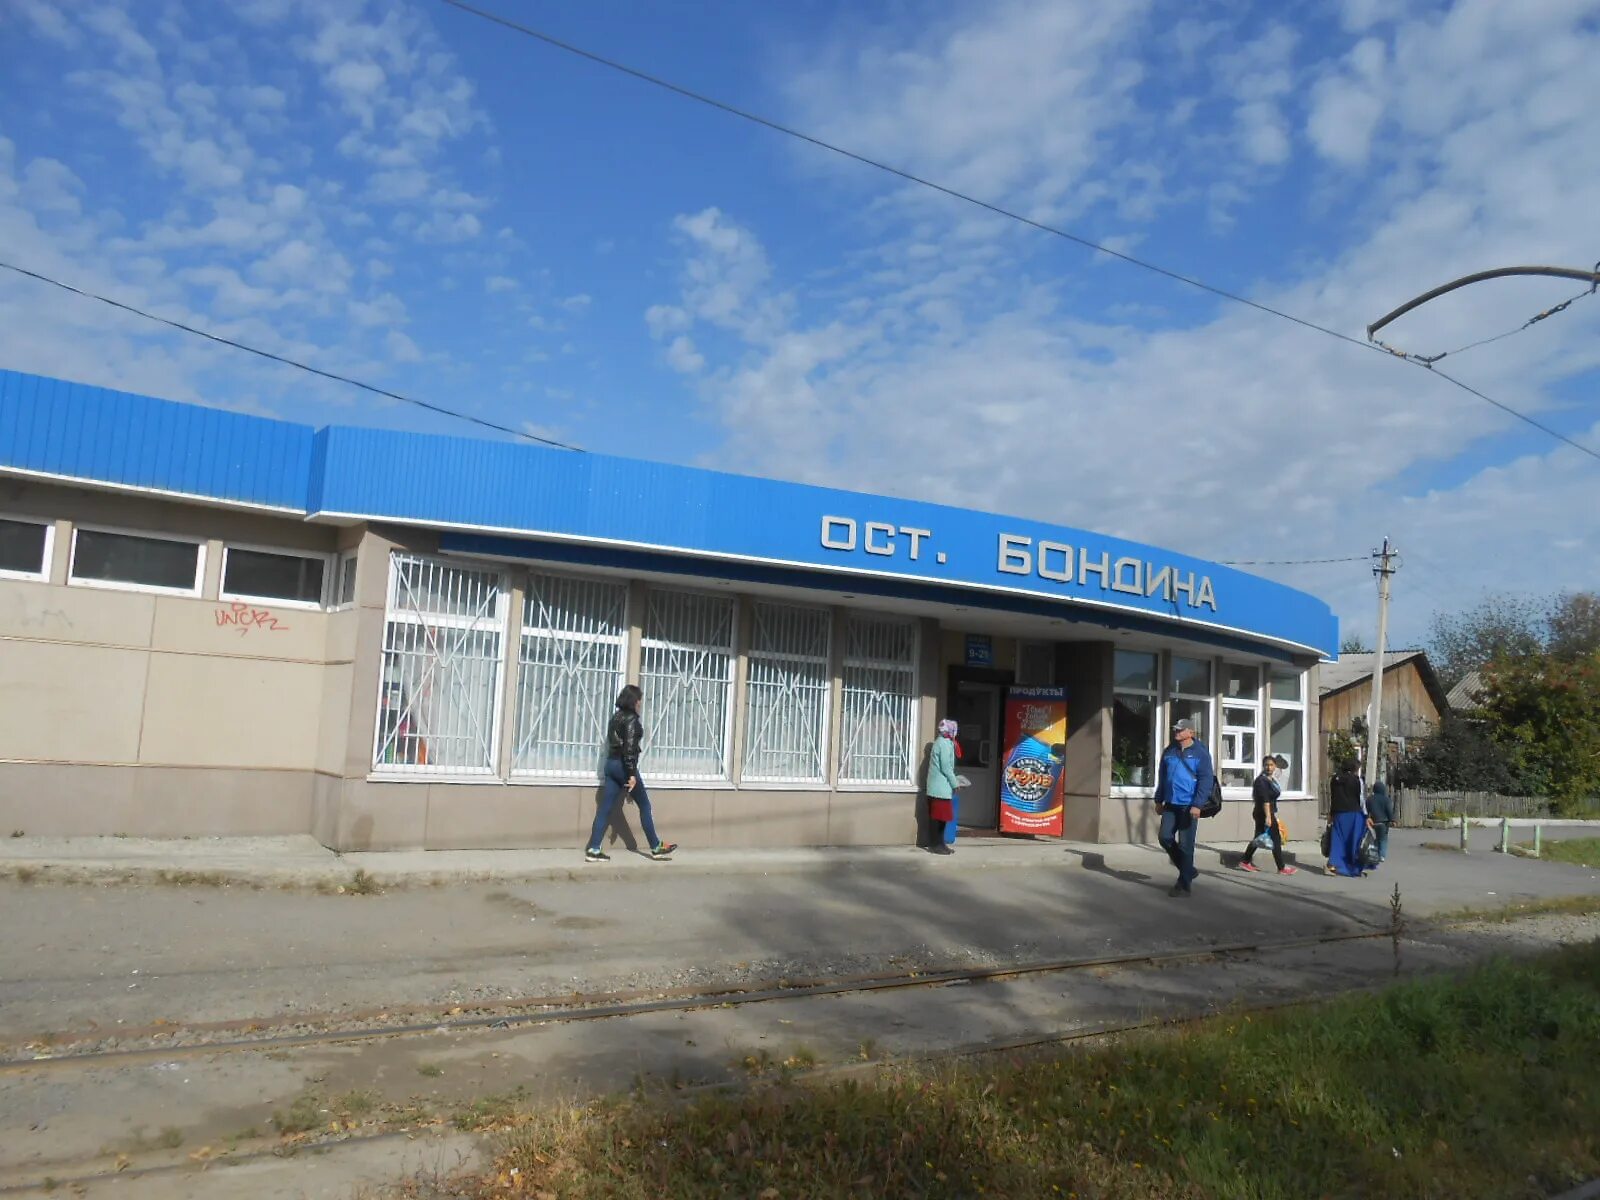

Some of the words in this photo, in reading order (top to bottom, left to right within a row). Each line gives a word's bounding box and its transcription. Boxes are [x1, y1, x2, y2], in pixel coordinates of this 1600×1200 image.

[821, 515, 947, 564] ОСТ.
[998, 533, 1217, 612] БОНДИНА
[1009, 687, 1064, 697] ПРОДУКТЫ
